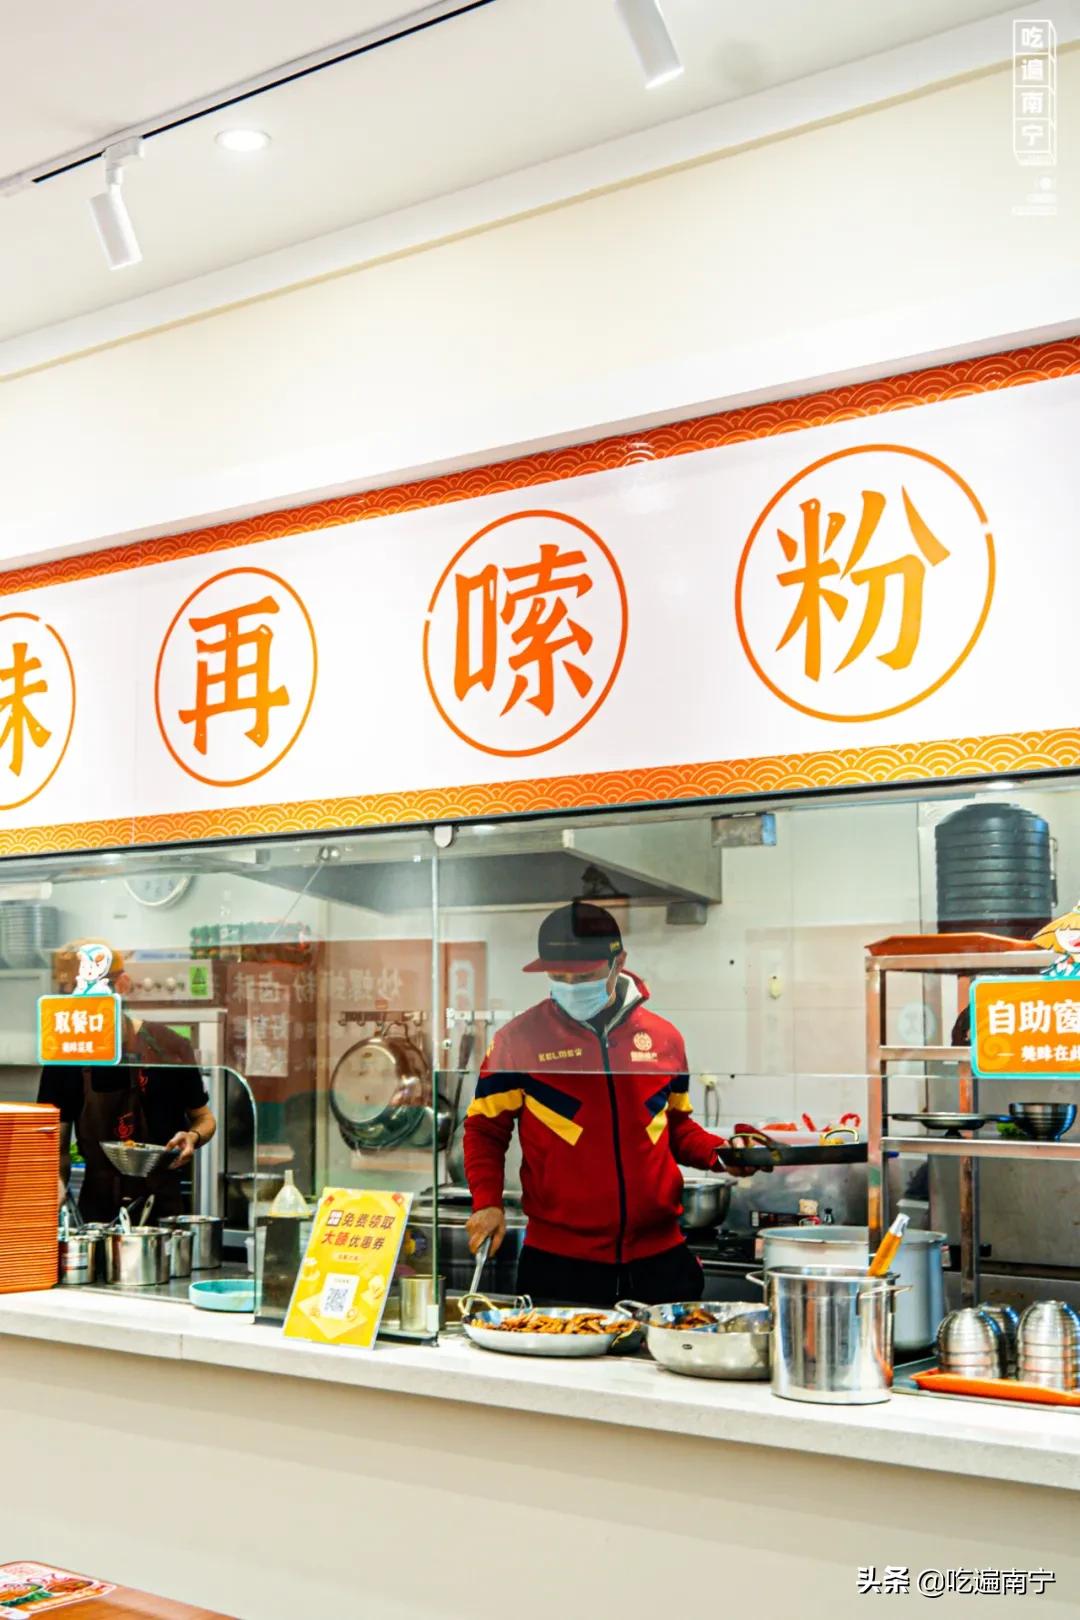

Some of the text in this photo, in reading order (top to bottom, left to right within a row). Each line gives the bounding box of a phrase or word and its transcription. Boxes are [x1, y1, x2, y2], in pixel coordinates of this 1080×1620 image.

[54, 1009, 104, 1035] 取餐口
[342, 1212, 395, 1230] 免费领取
[321, 1231, 385, 1250] 大额优惠券
